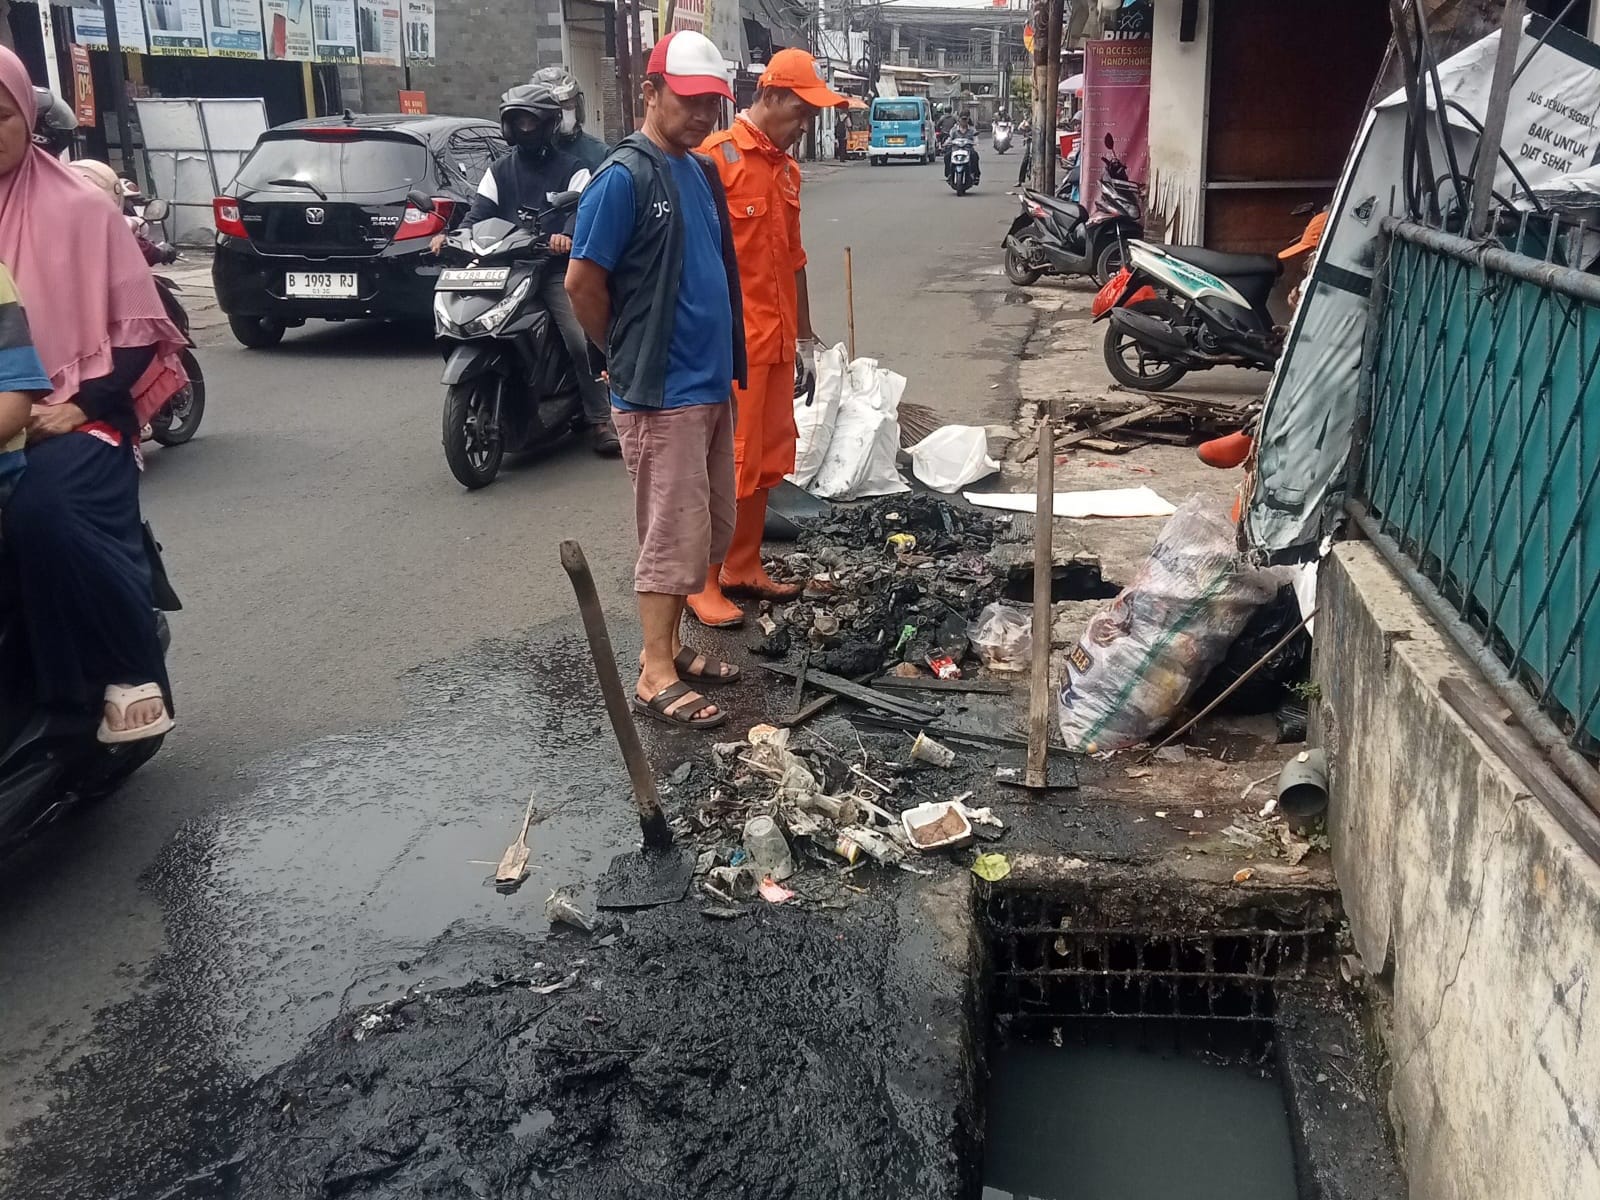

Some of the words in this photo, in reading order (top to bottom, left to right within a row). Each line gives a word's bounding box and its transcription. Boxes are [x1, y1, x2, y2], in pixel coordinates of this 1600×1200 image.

[1527, 91, 1543, 106] JUS
[1544, 97, 1570, 117] JERUK
[1528, 122, 1553, 144] BAIK
[1553, 133, 1588, 159] UNTUK
[1520, 143, 1542, 161] DIET
[1541, 152, 1572, 174] SEHAT
[288, 274, 296, 288] B
[304, 274, 332, 288] 1993
[340, 274, 354, 288] RJ
